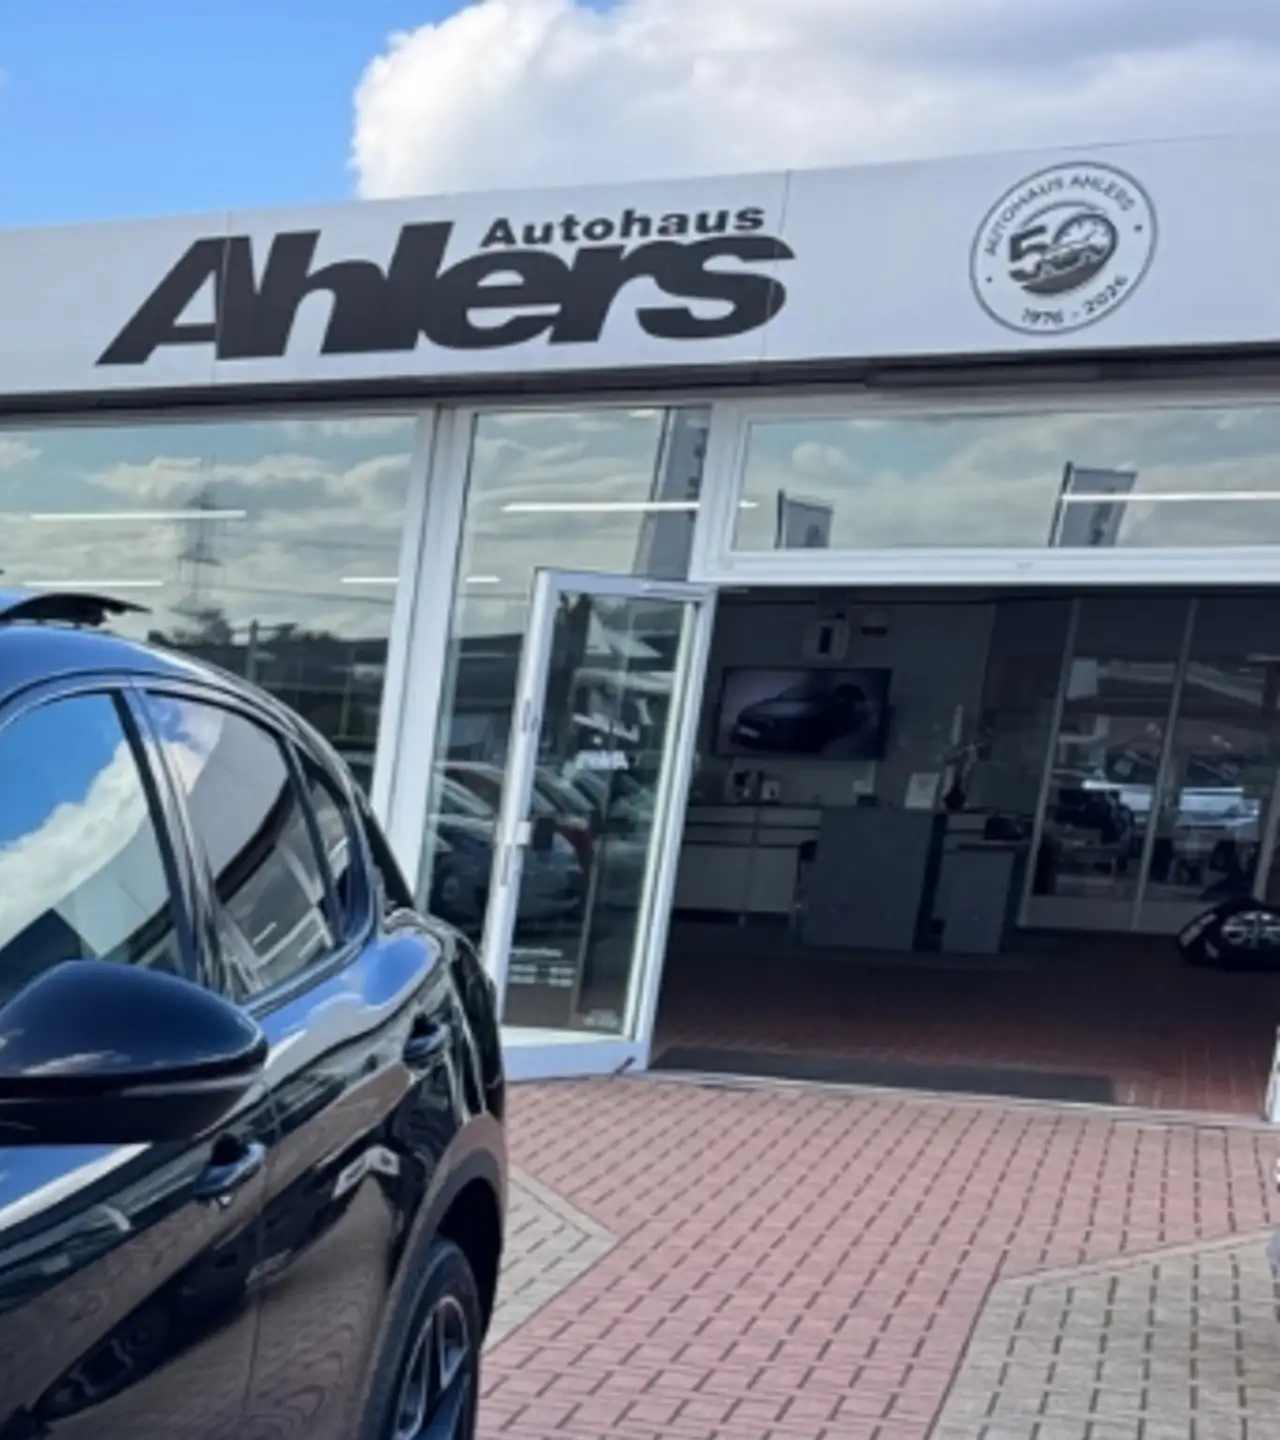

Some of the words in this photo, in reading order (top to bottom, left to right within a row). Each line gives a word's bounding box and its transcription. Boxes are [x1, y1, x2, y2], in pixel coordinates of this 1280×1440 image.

[480, 206, 766, 248] Autohaus
[985, 176, 1064, 257] AUTOHAUS
[1070, 174, 1137, 212] AHLERS
[94, 220, 797, 367] Ahlers
